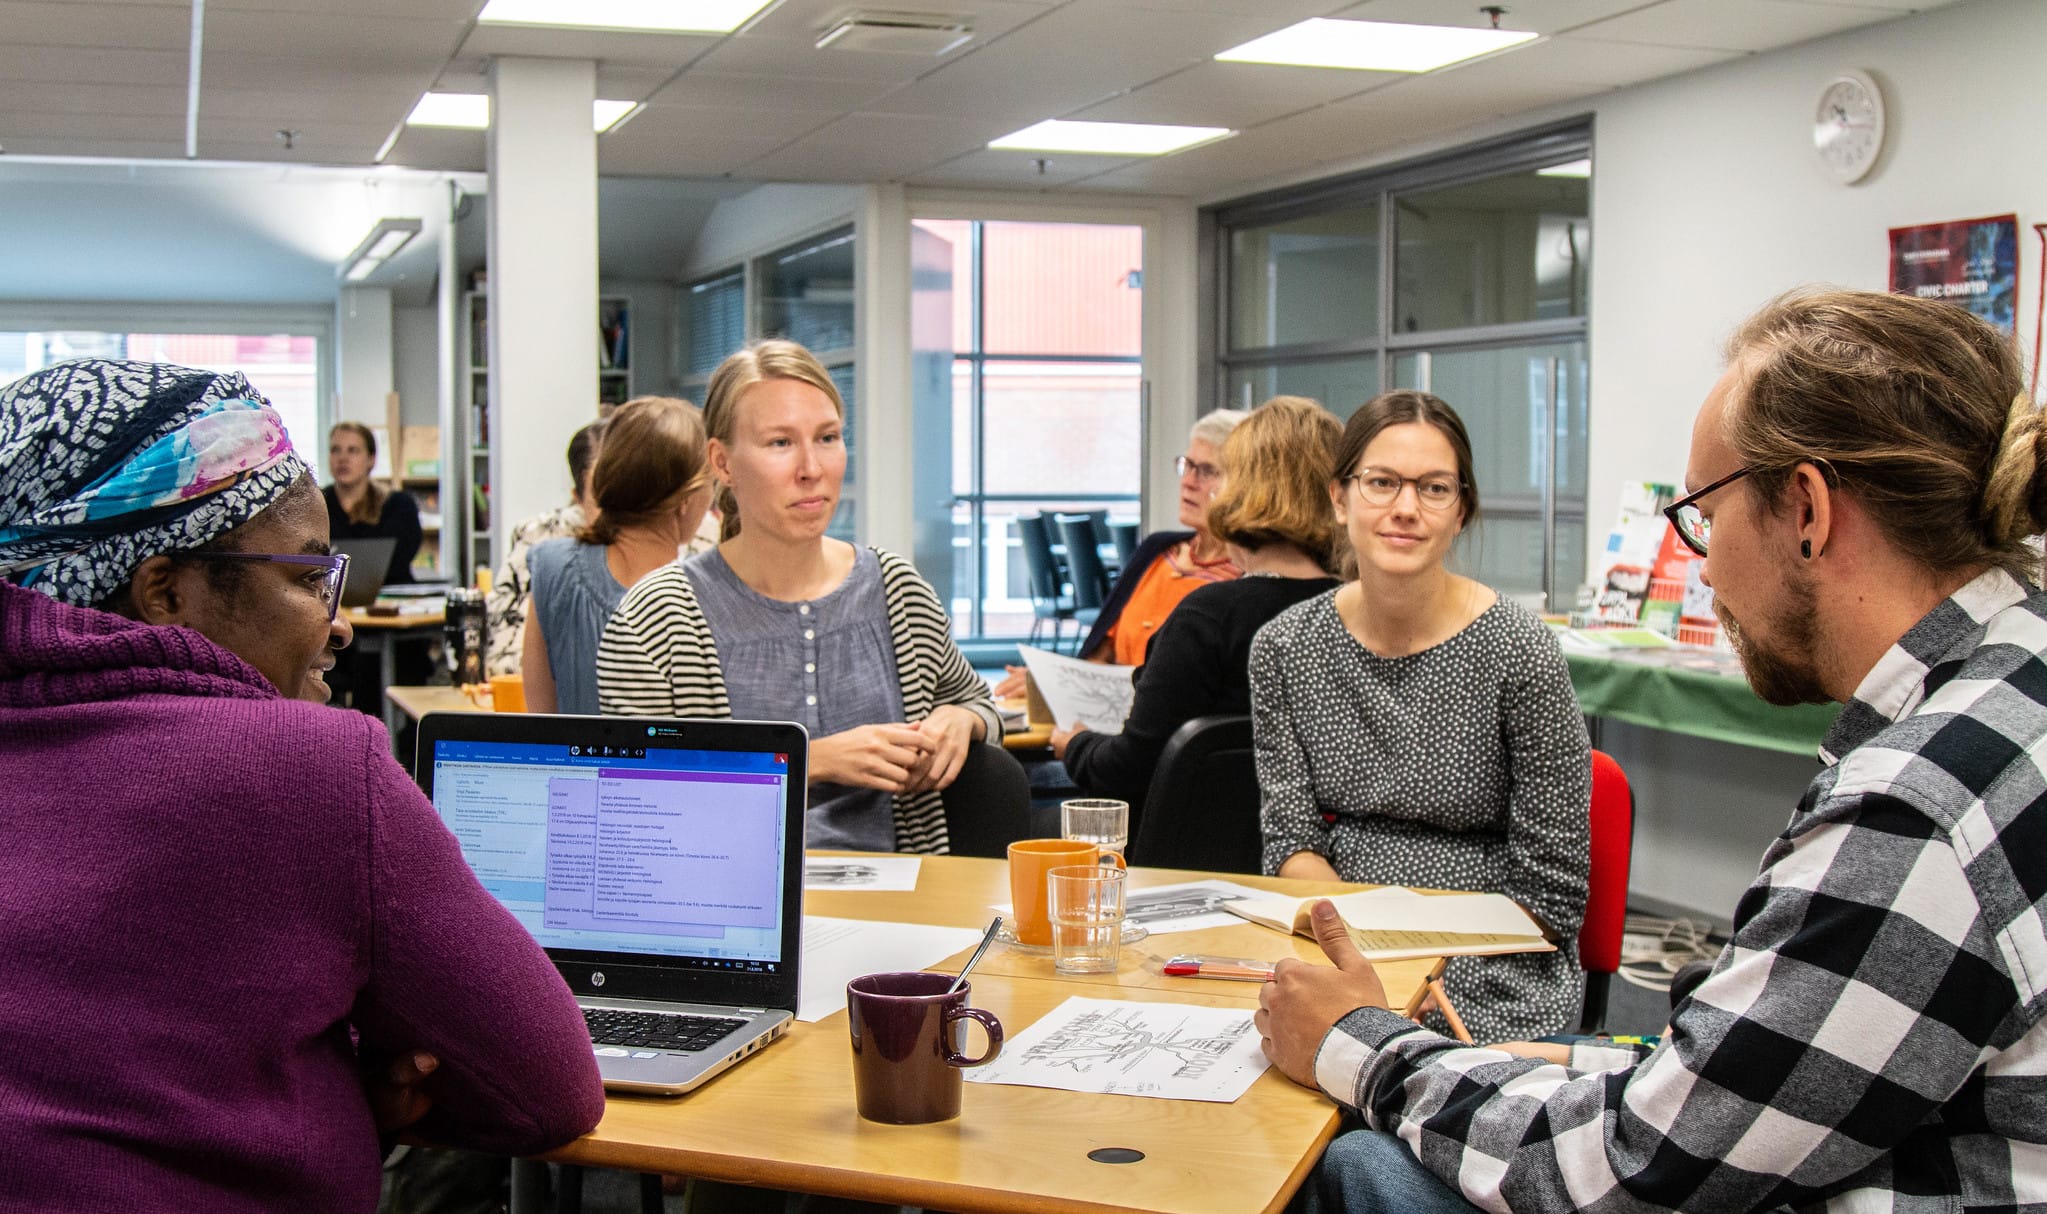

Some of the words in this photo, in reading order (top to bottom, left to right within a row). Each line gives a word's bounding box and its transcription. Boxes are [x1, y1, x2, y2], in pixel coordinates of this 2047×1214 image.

[1917, 284, 1943, 297] CIVIC
[1944, 280, 1988, 296] CHARTER
[591, 971, 606, 987] hp
